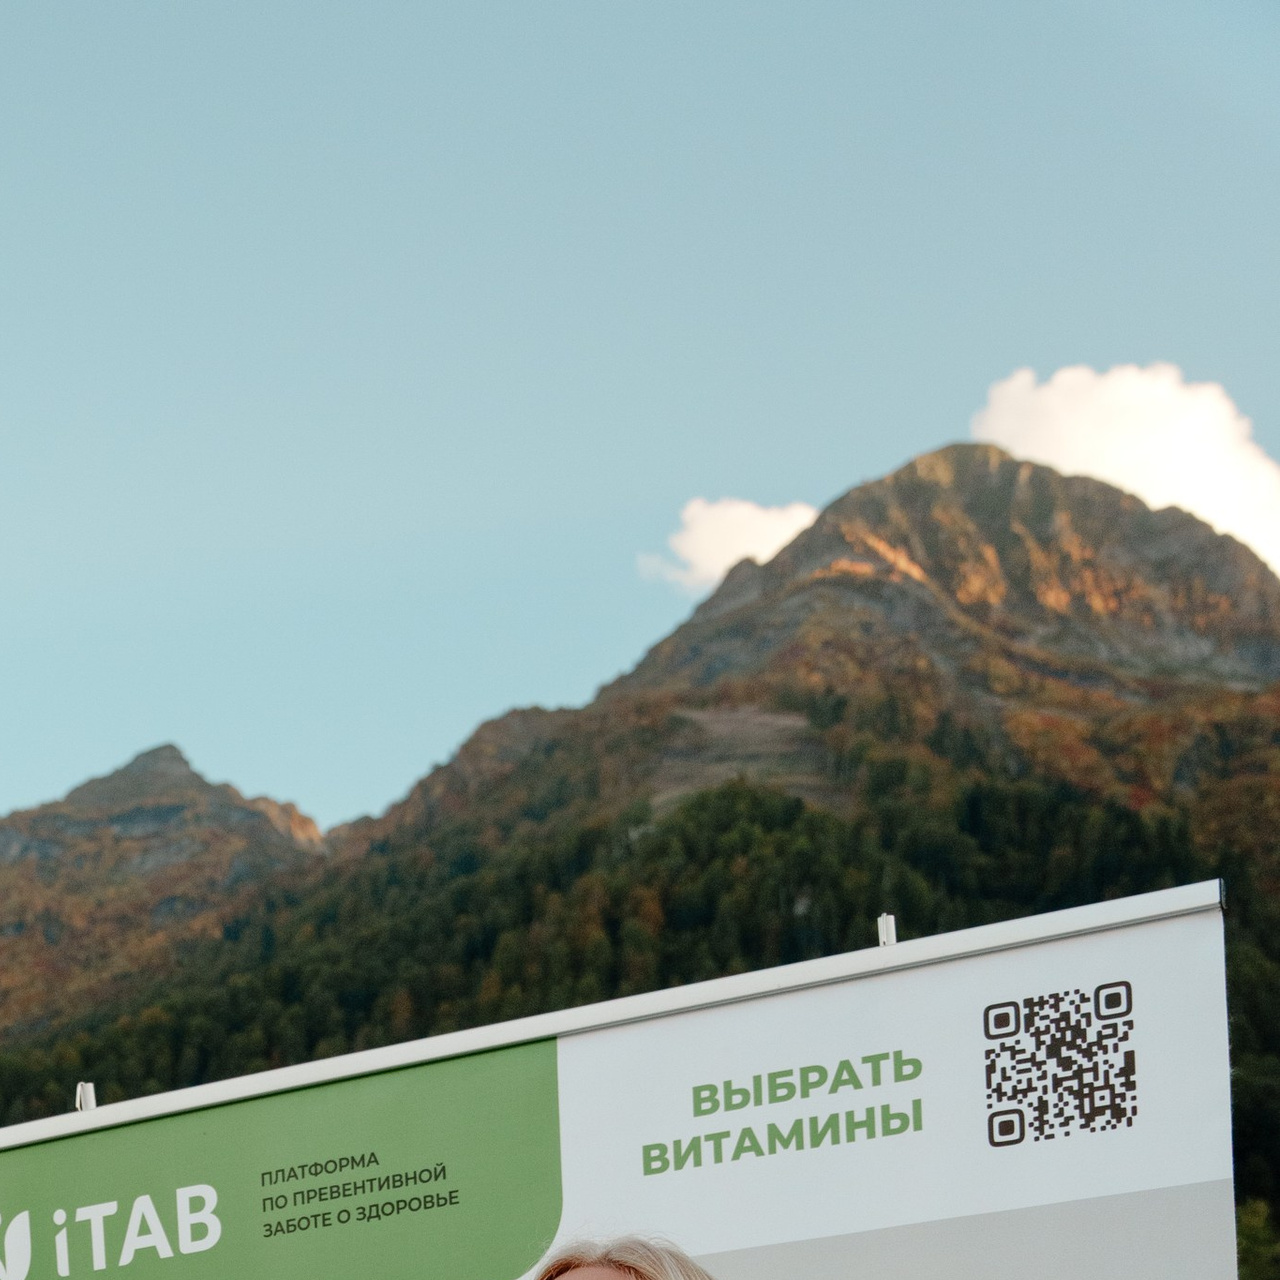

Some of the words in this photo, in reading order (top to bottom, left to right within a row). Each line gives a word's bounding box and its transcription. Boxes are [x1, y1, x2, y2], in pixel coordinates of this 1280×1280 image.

[691, 1048, 924, 1118] ВЫБРАТЬ
[641, 1099, 925, 1177] ВИТАМИНЫ
[260, 1152, 380, 1188] ПЛАТФОРМА
[261, 1194, 288, 1213] ПО
[291, 1162, 448, 1209] ПРЕВЕНТИВНОЙ
[53, 1183, 222, 1278] iTAB
[262, 1210, 332, 1238] ЗАБОТЕ
[336, 1207, 351, 1225] О
[355, 1189, 461, 1223] ЗДОРОВЬЕ
